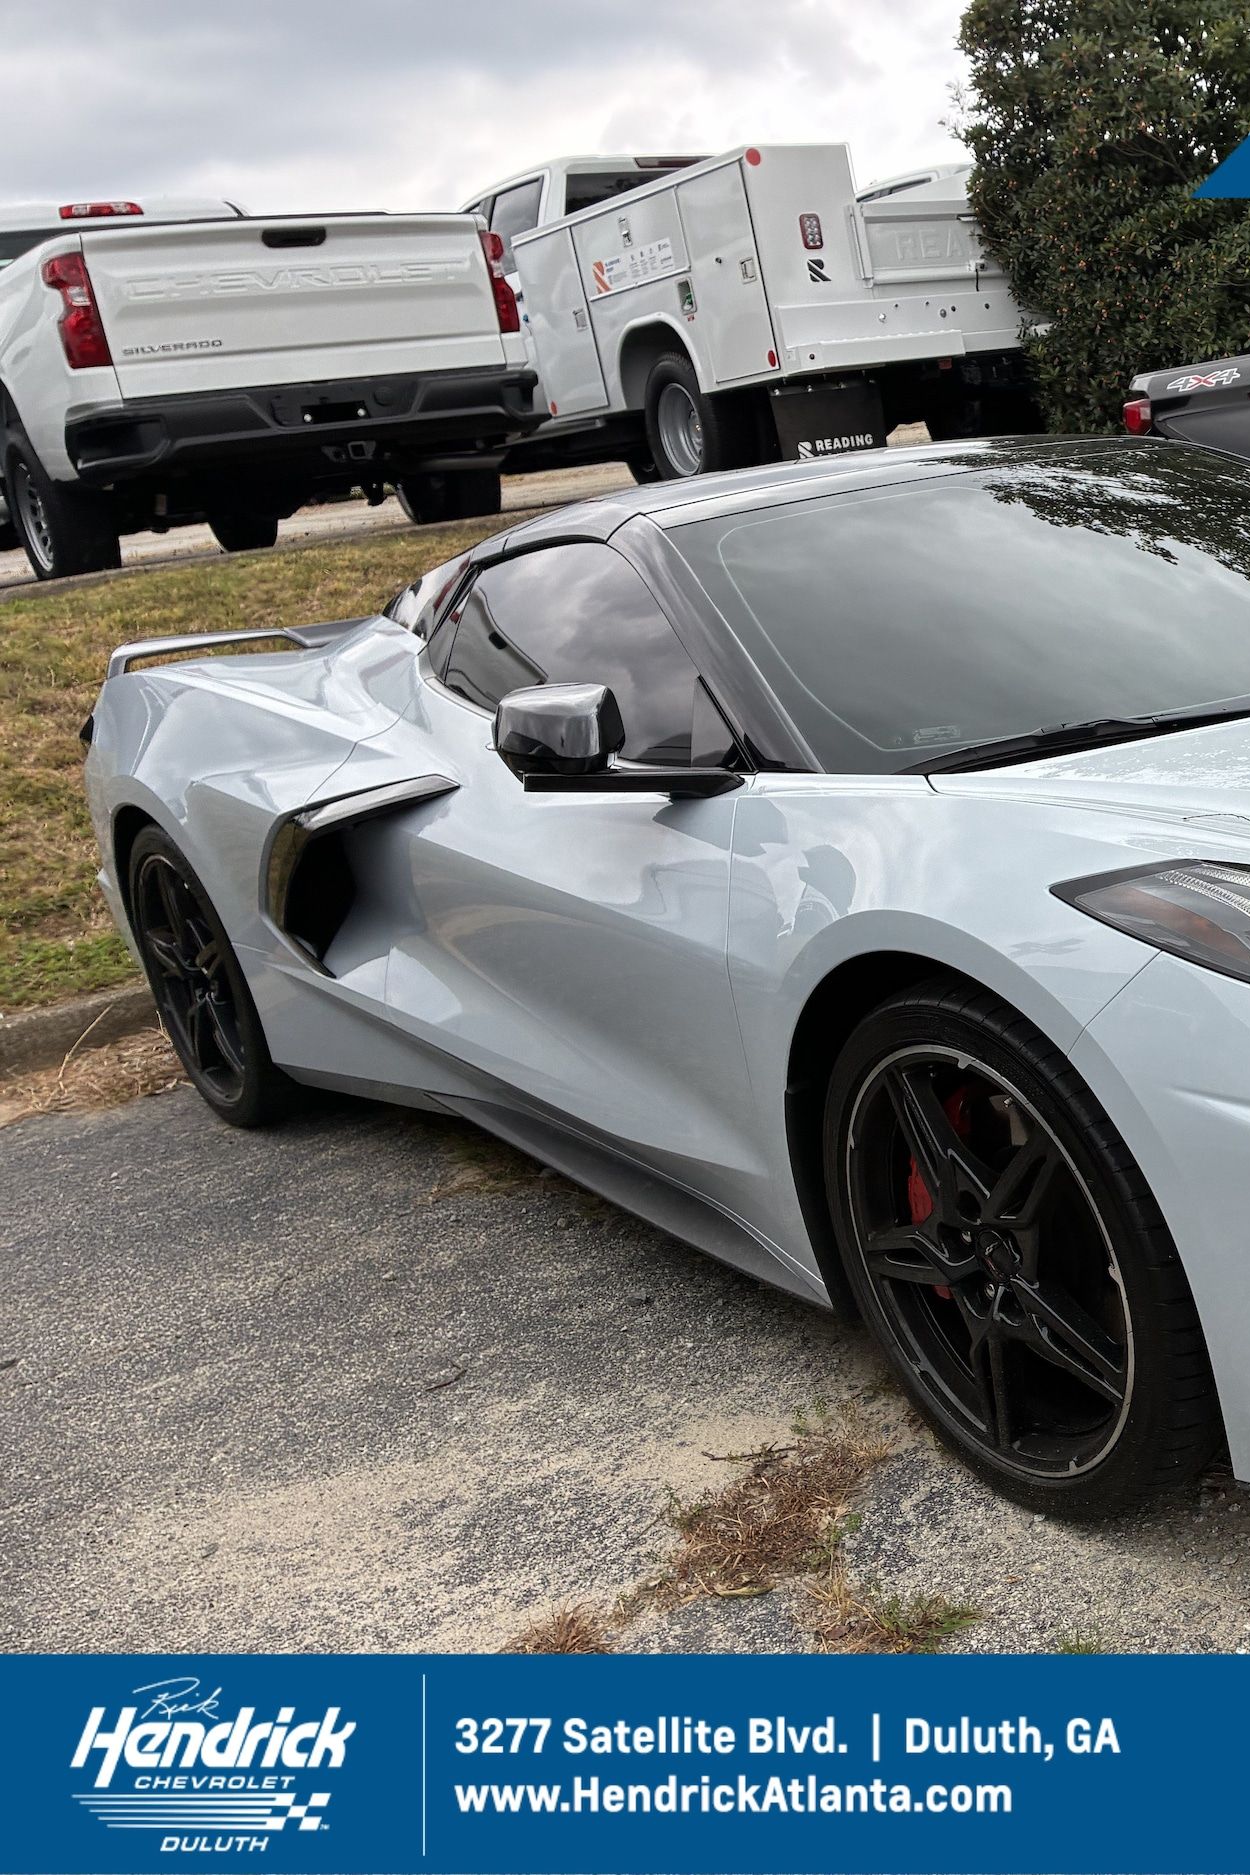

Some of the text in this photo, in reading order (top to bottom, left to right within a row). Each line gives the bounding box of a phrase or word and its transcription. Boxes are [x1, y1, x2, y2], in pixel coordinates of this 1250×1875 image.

[123, 259, 466, 300] CHEVROLET
[121, 339, 223, 356] SILVERADO
[815, 433, 874, 452] READING
